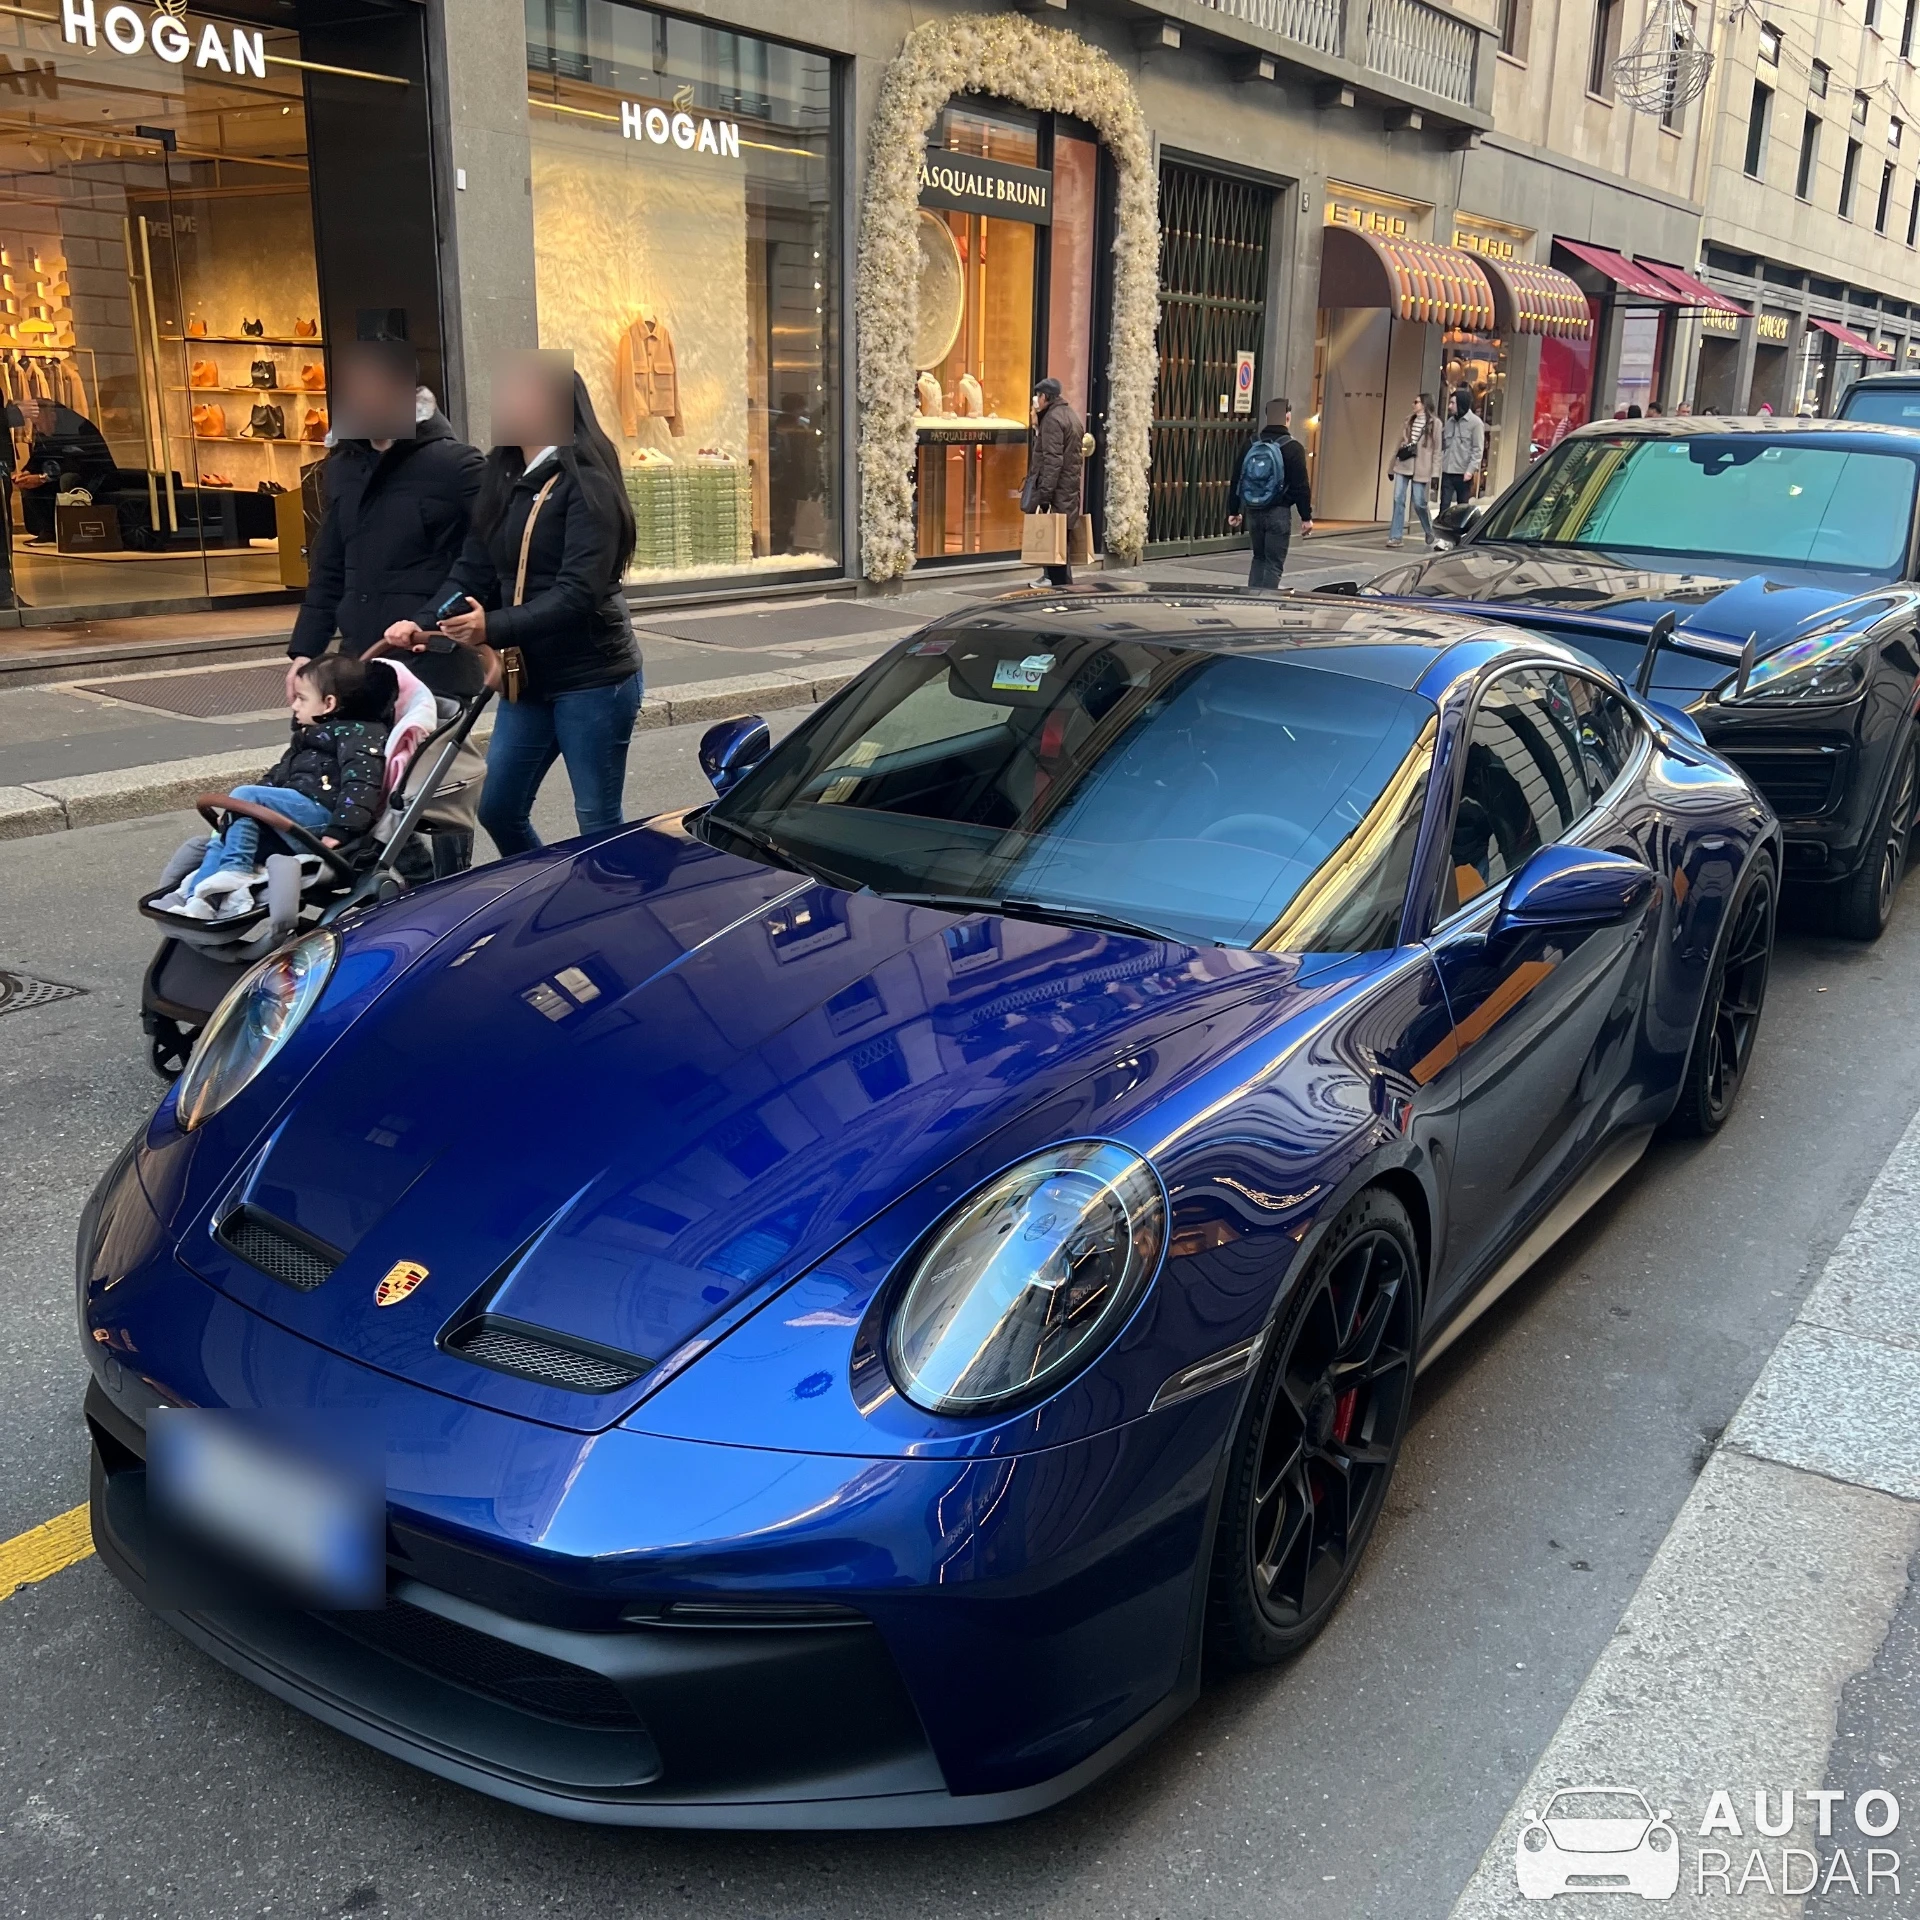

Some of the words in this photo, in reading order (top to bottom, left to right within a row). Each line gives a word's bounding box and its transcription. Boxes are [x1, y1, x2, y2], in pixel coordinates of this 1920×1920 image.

[62, 0, 266, 78] HOGAN
[621, 100, 739, 158] HOGAN
[996, 179, 1047, 208] BRUNI
[1303, 193, 1309, 207] 5
[1331, 203, 1407, 235] ETRO
[1456, 230, 1514, 258] ETRO
